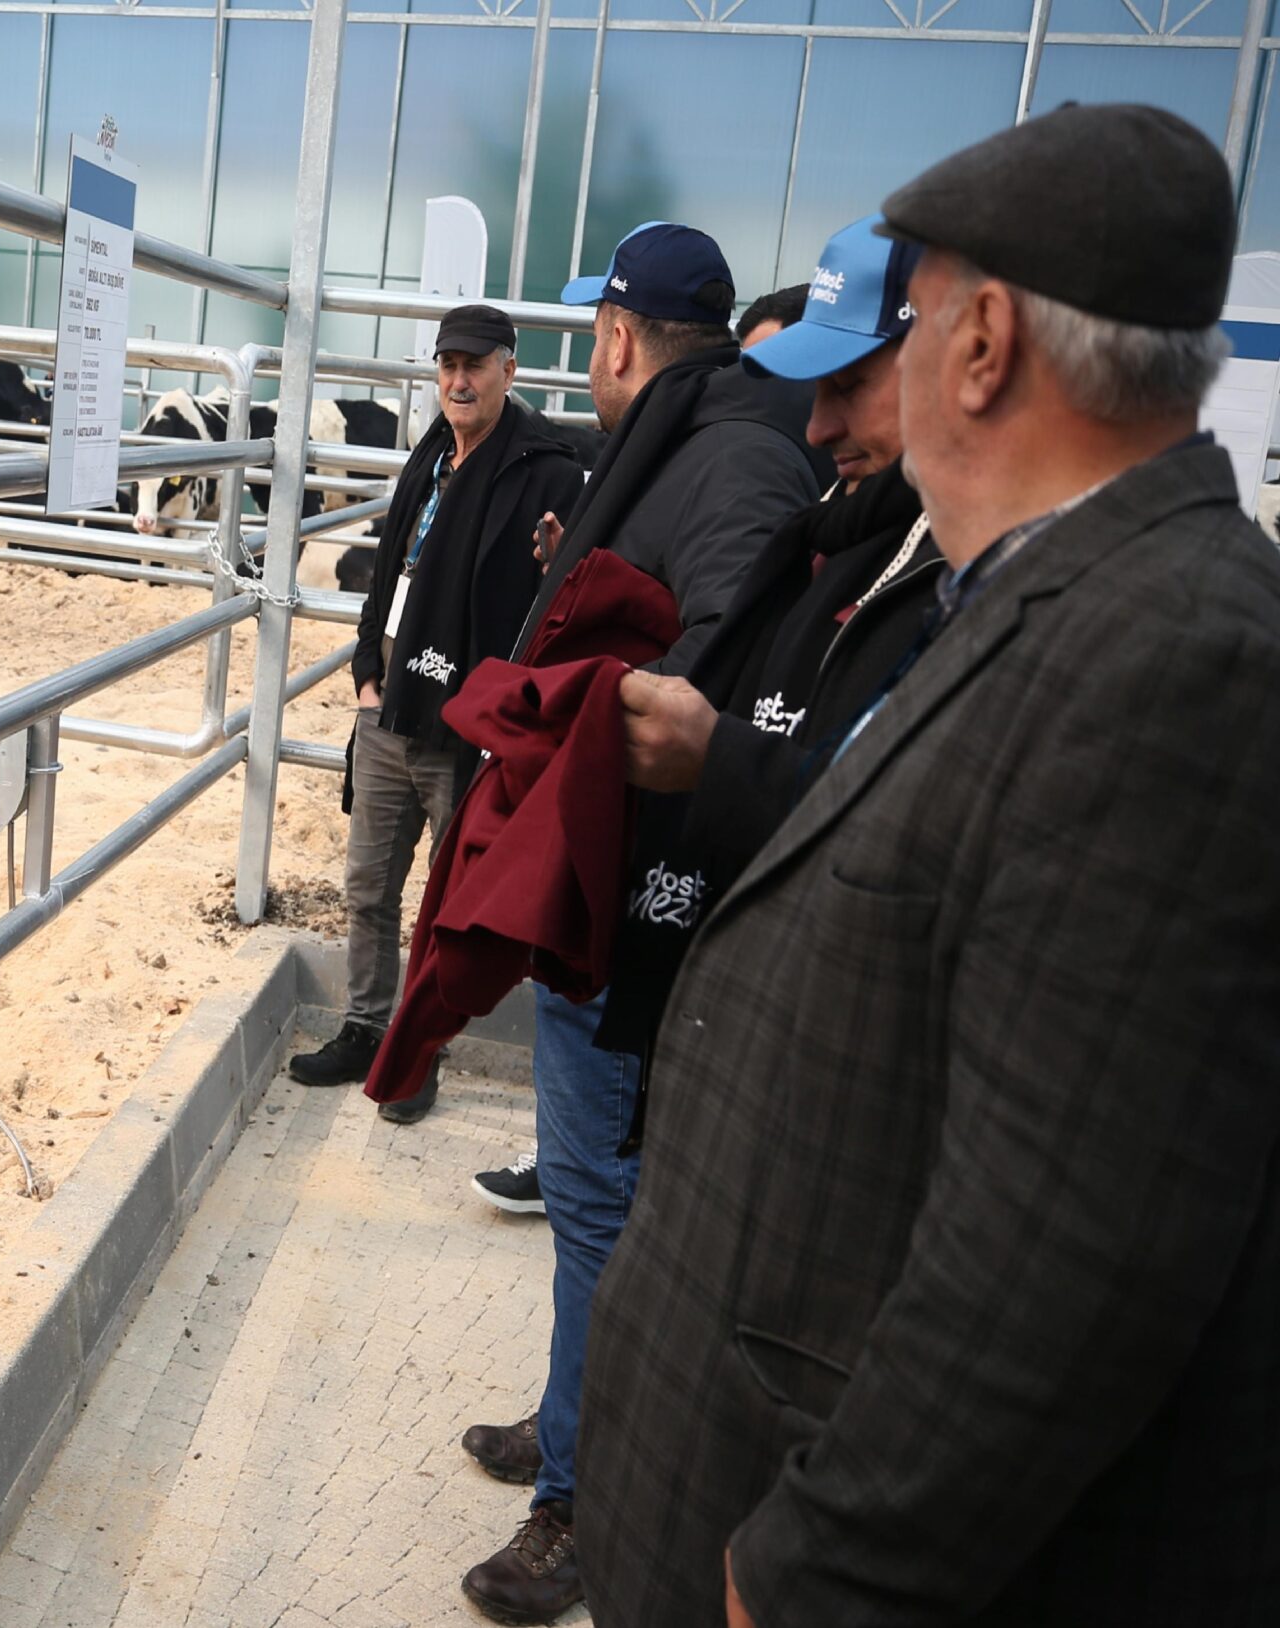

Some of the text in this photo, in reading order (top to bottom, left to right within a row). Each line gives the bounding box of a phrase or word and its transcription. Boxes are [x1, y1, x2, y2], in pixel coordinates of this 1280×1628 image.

[610, 275, 629, 292] dost
[754, 691, 784, 721] ost
[646, 861, 706, 900] dost
